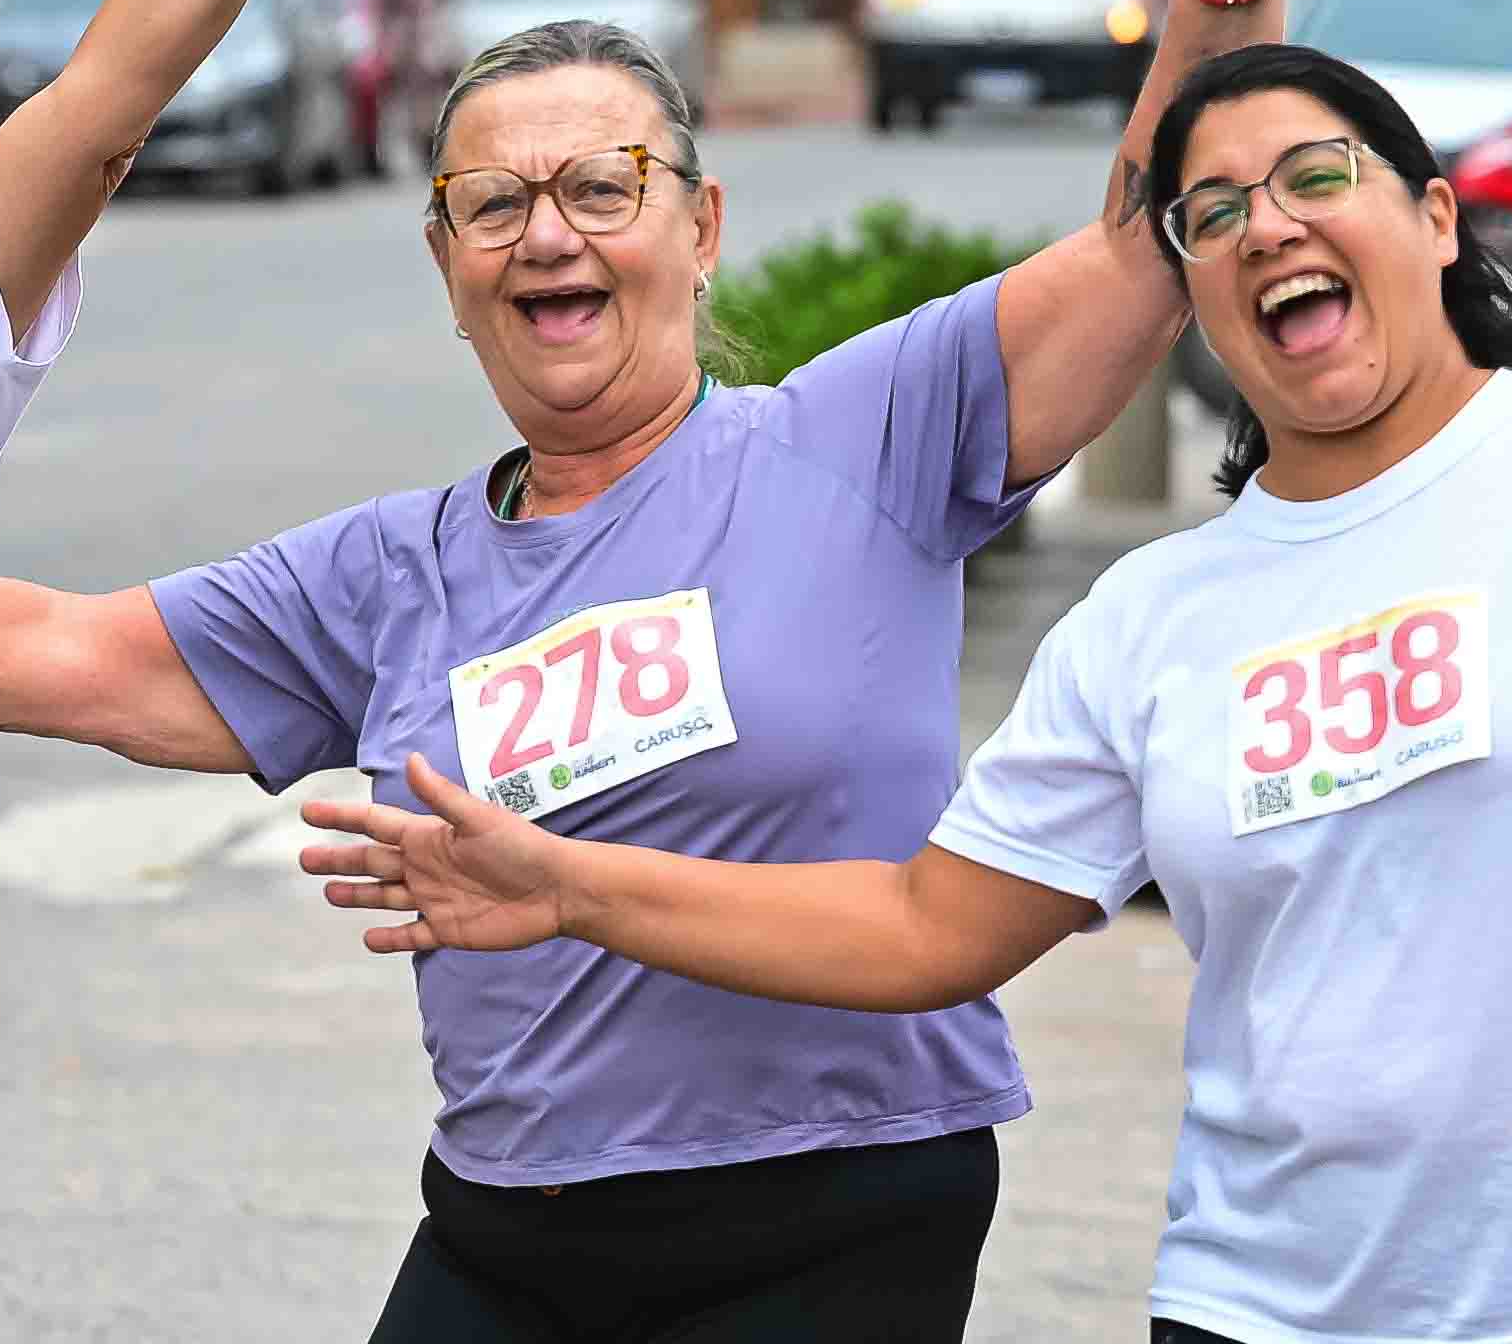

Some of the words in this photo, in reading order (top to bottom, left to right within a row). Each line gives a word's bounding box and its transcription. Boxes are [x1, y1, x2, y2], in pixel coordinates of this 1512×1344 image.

[480, 616, 690, 778] 278
[634, 716, 706, 753] CARUSO
[1244, 610, 1462, 774] 358
